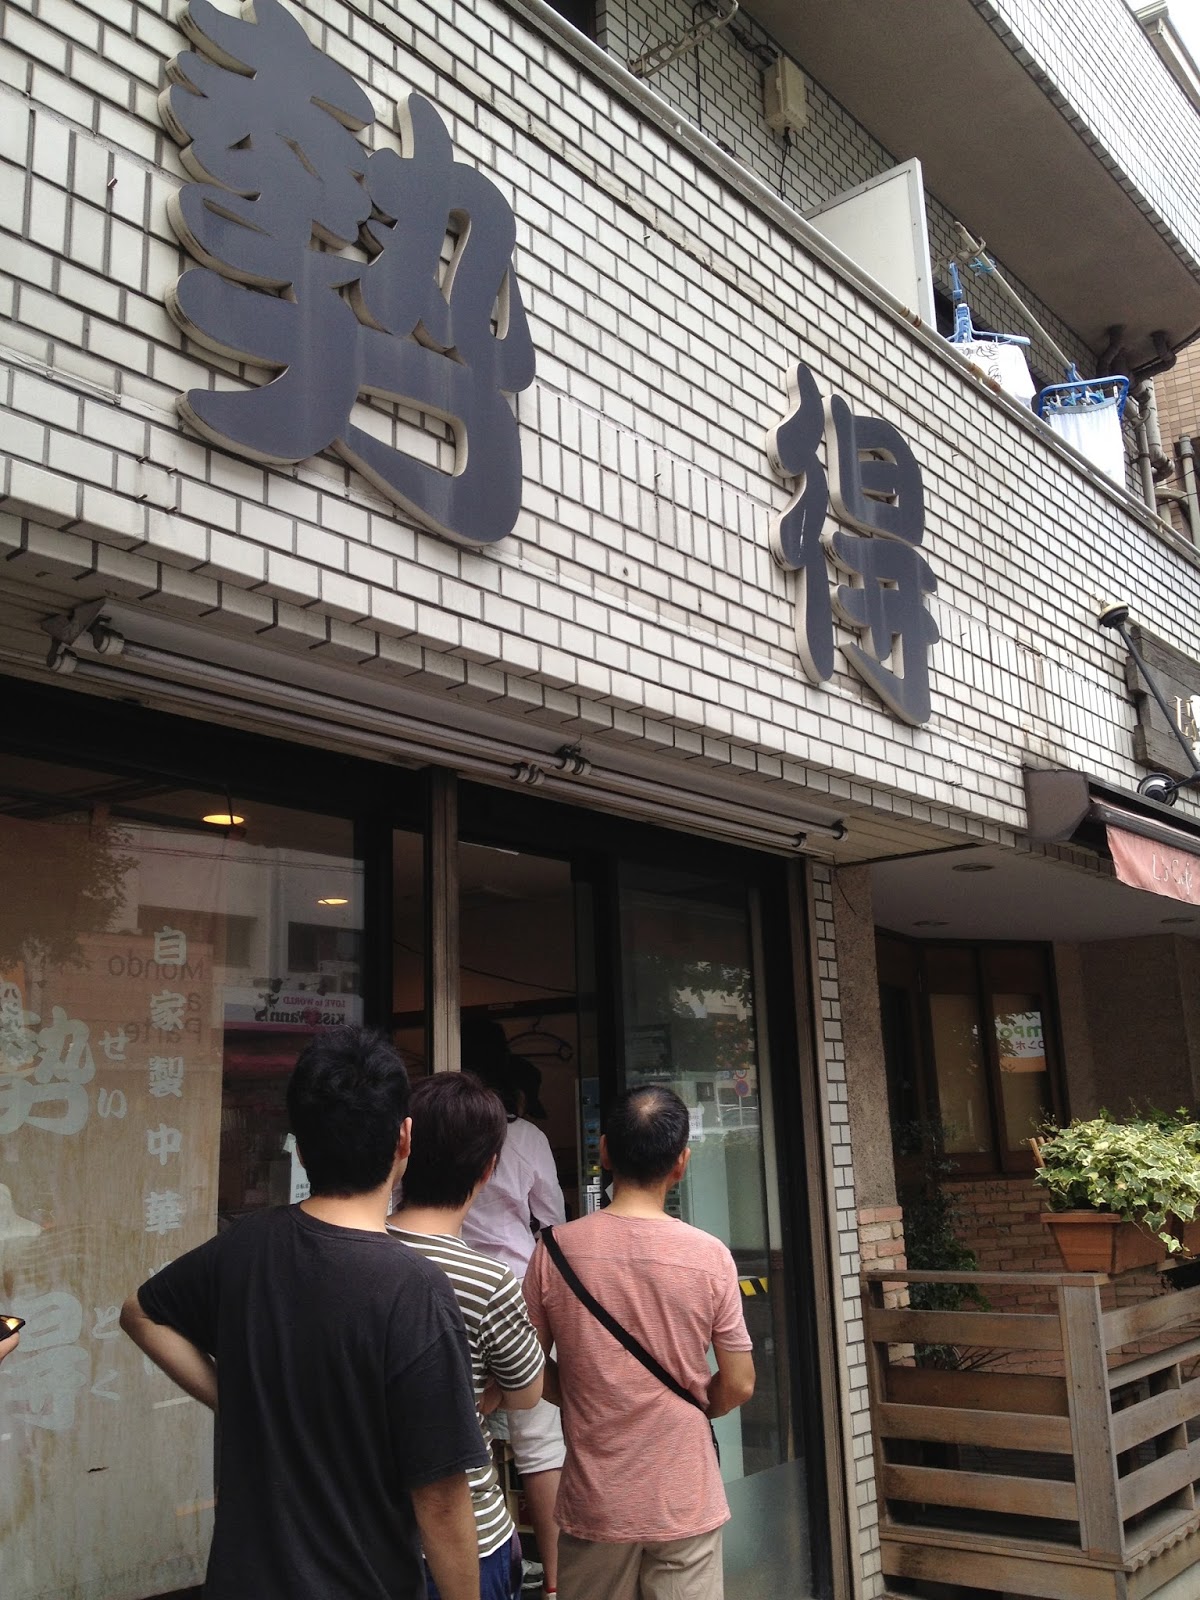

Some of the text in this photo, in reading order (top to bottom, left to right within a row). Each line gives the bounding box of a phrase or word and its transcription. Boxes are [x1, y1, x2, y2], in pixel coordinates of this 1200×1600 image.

[98, 1028, 131, 1119] せい
[144, 926, 188, 1375] 自家製中華
